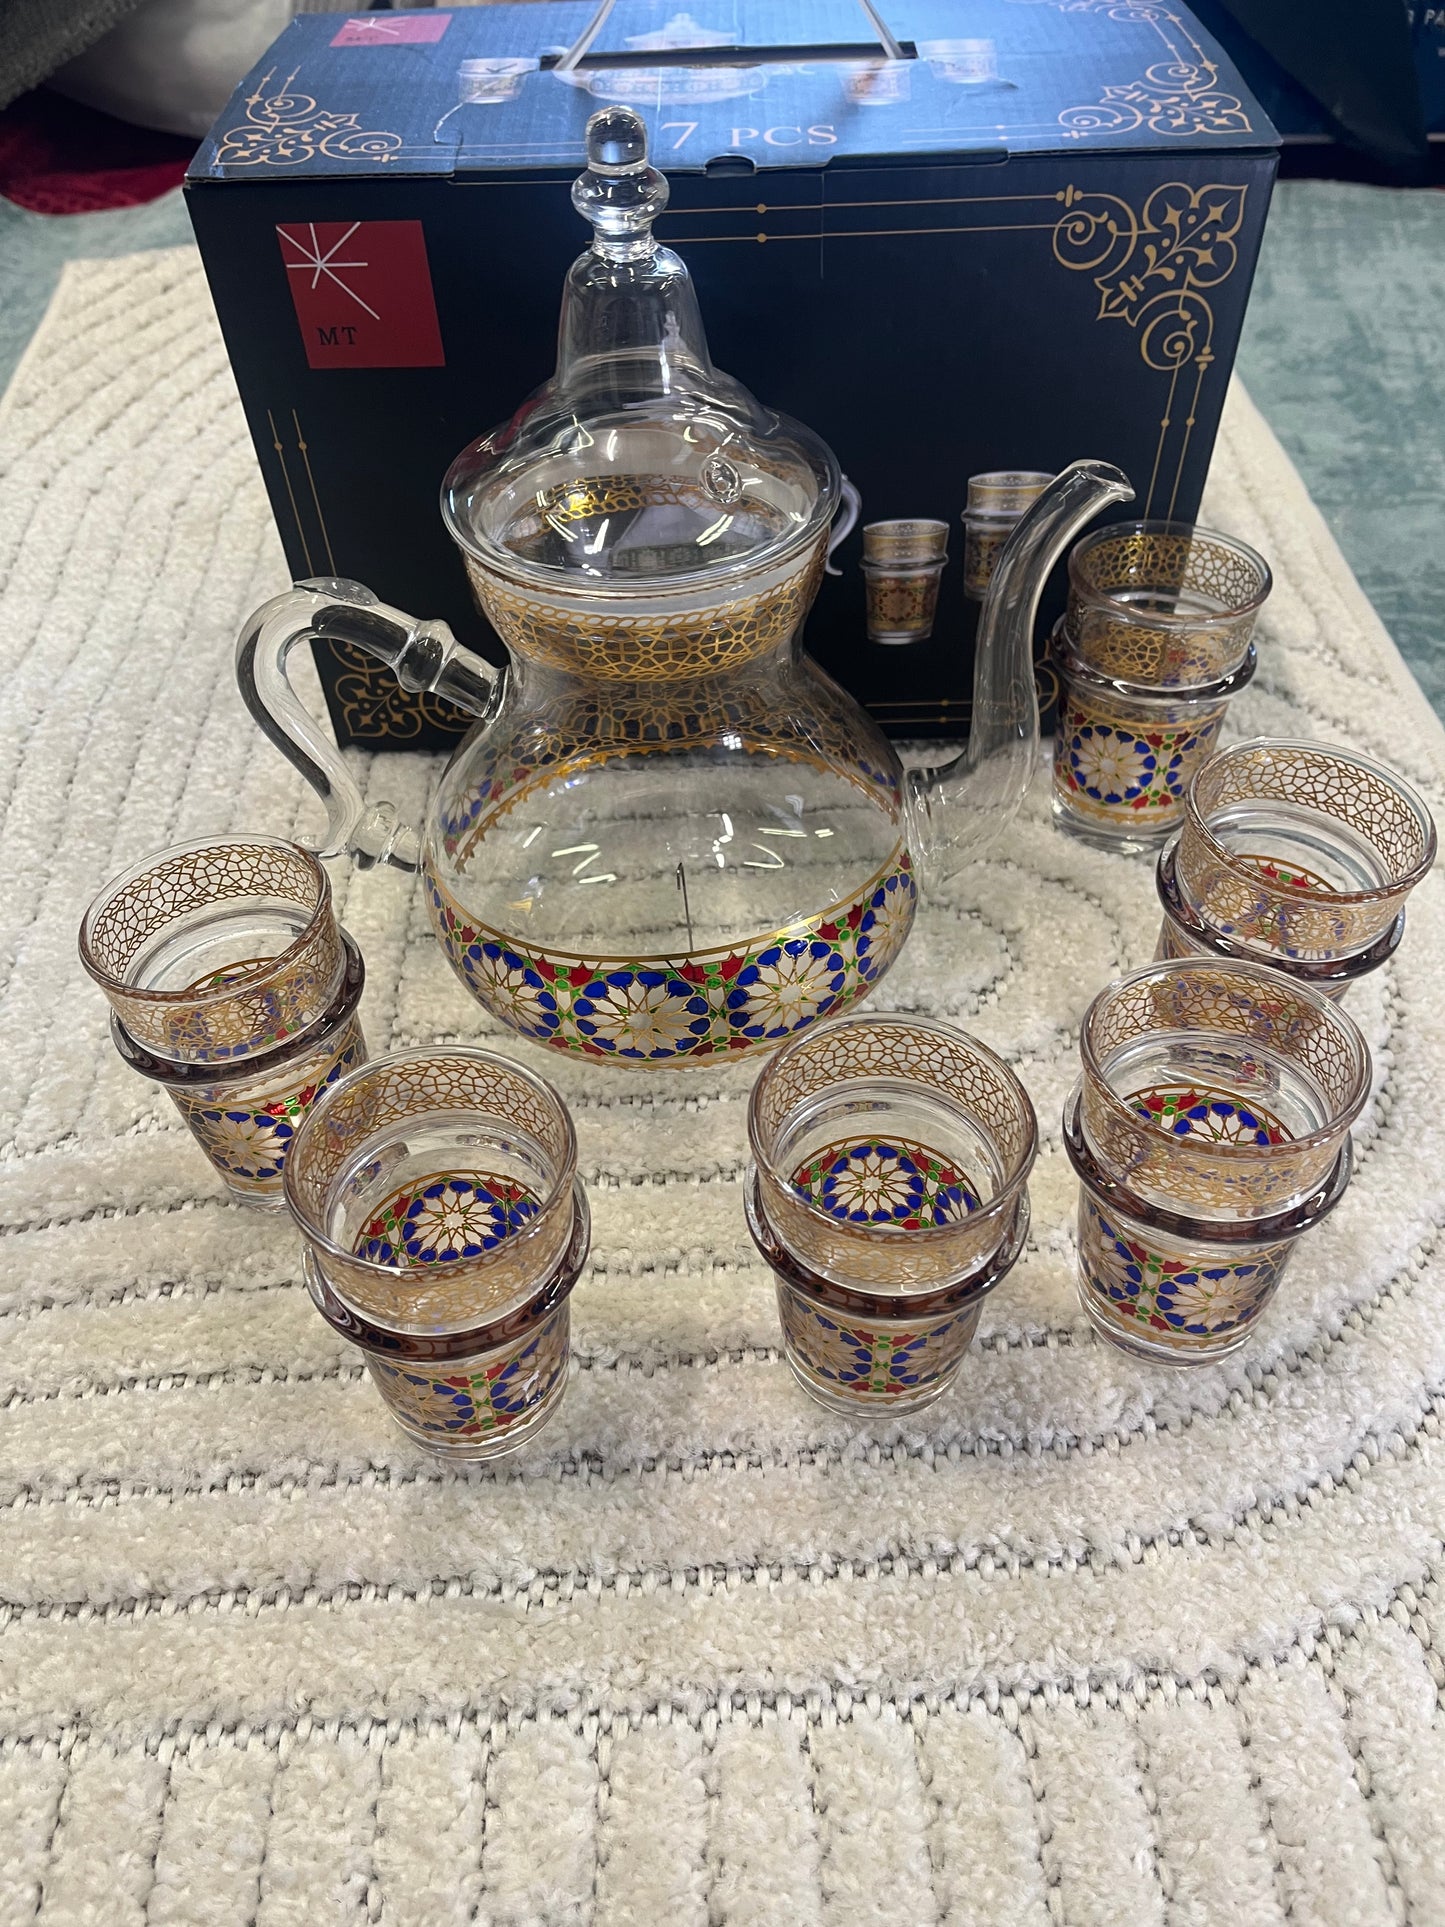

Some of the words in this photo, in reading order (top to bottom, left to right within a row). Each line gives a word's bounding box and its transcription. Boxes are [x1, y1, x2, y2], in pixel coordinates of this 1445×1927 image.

[660, 121, 699, 150] 7
[728, 124, 838, 147] PCS
[317, 326, 357, 346] MT
